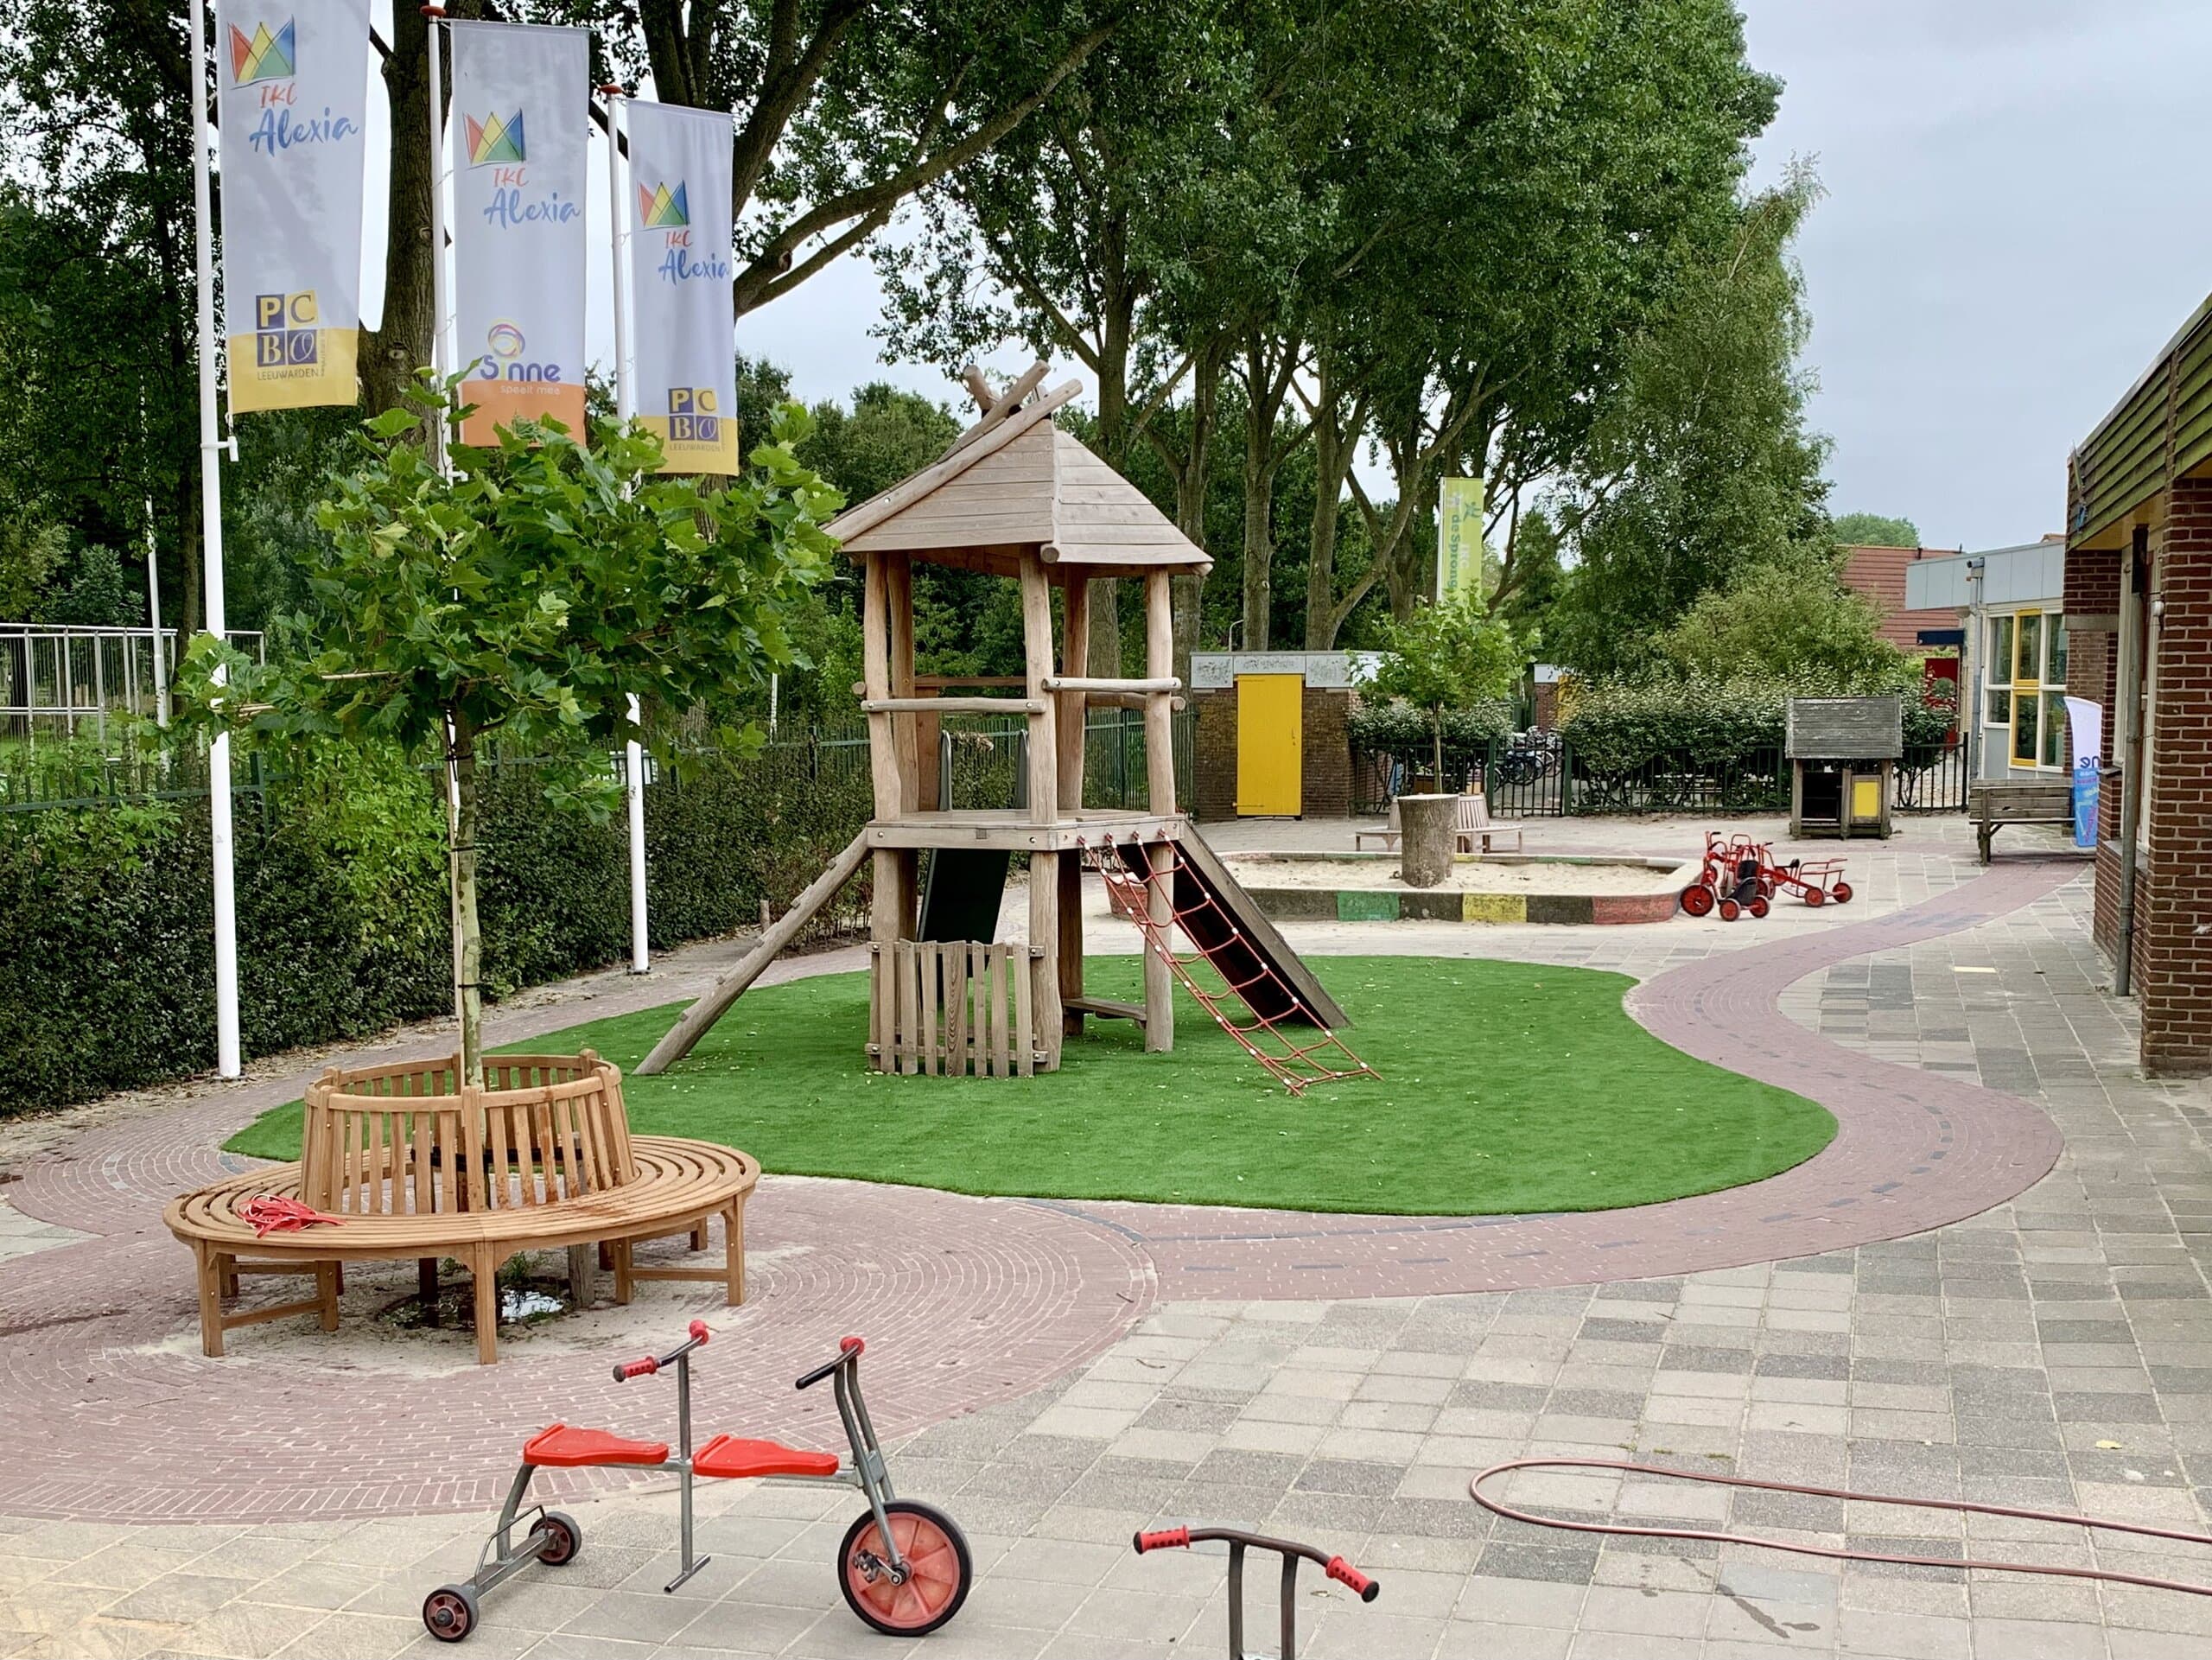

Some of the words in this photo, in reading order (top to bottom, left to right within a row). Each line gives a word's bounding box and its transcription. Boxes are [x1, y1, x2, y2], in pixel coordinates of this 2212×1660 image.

[260, 83, 297, 109] IKC
[249, 107, 359, 157] Alexia
[493, 167, 530, 188] IKC
[484, 188, 581, 231] Alexia
[664, 230, 693, 249] IKC
[658, 248, 730, 286] Alexia
[257, 367, 320, 380] LEEUWARDEN
[480, 354, 561, 383] Sinne
